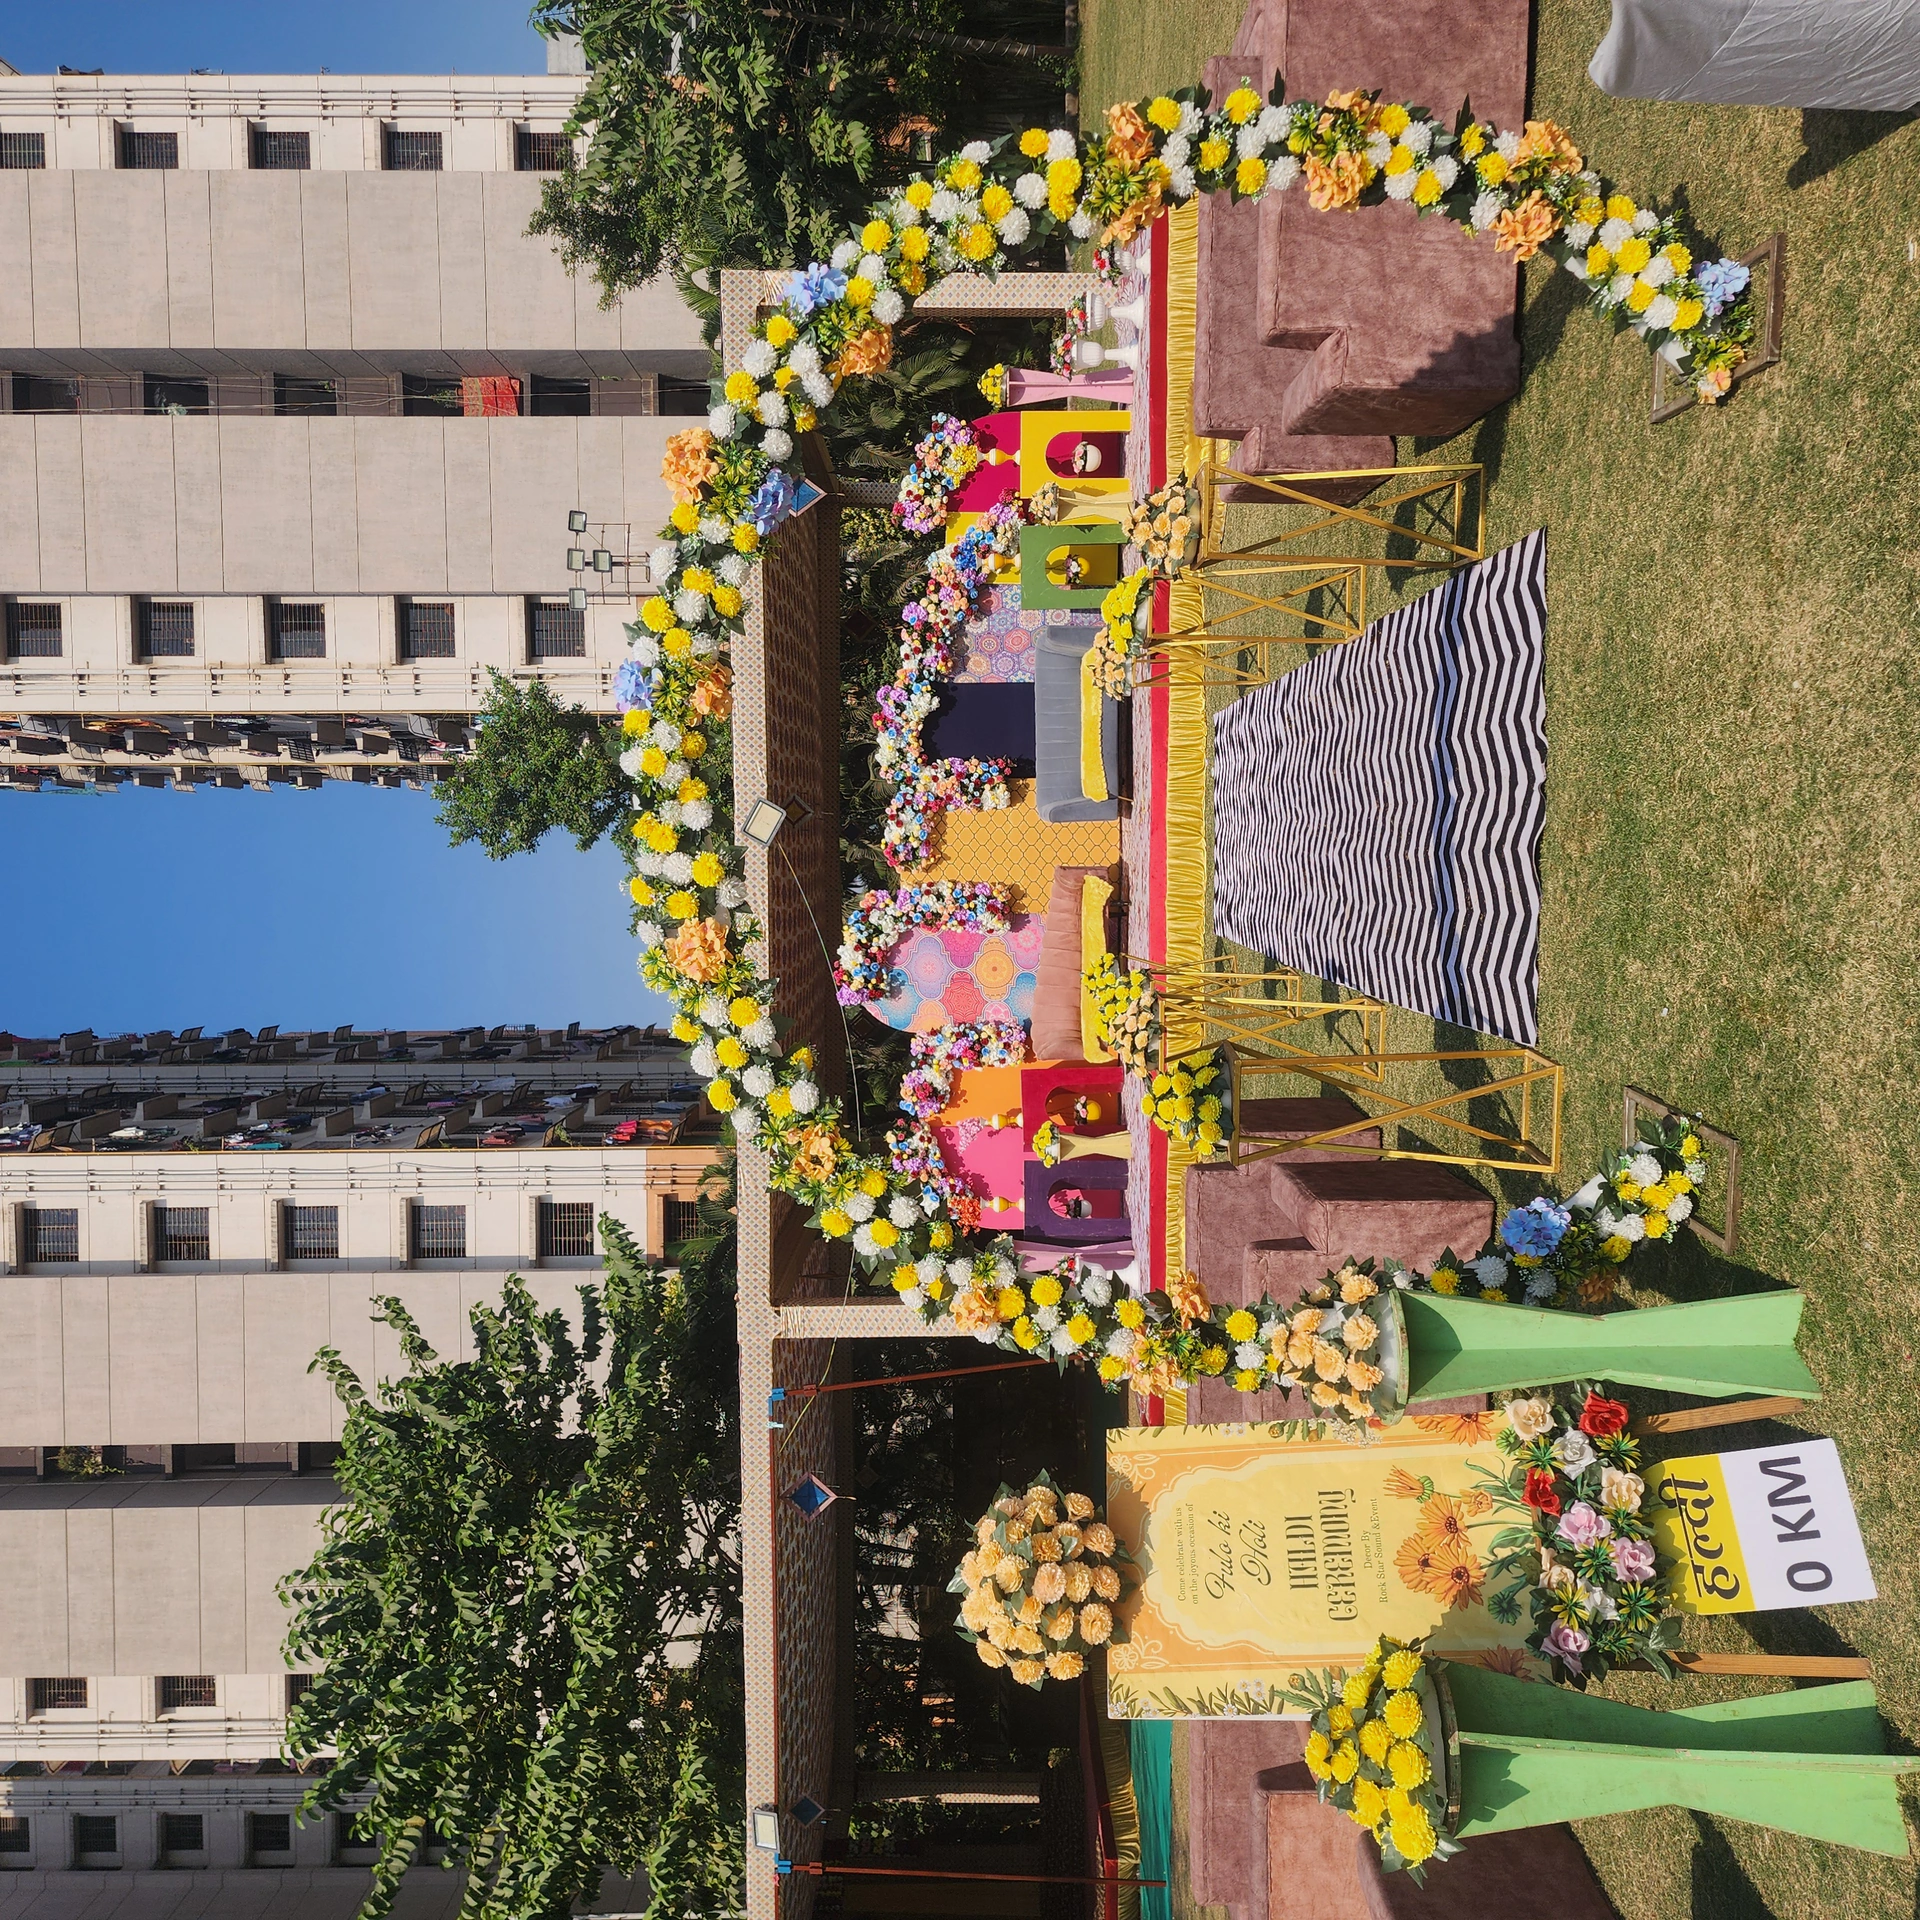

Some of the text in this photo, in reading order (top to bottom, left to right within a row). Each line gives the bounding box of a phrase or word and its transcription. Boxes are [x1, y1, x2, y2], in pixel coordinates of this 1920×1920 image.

[1174, 1507, 1186, 1602] Come celebrate with us
[1186, 1503, 1199, 1604] on the joyous occasion of
[1204, 1510, 1235, 1600] Fulo ki
[1238, 1520, 1272, 1586] Holi
[1284, 1514, 1319, 1590] HALDI
[1317, 1488, 1358, 1621] CEREMONY
[1361, 1530, 1373, 1569] Decor By
[1372, 1532, 1383, 1558] Sound
[1657, 1473, 1740, 1600] हल्दी
[1758, 1456, 1833, 1592] 0 KM
[1376, 1560, 1385, 1579] Star
[1377, 1582, 1388, 1603] Rock
